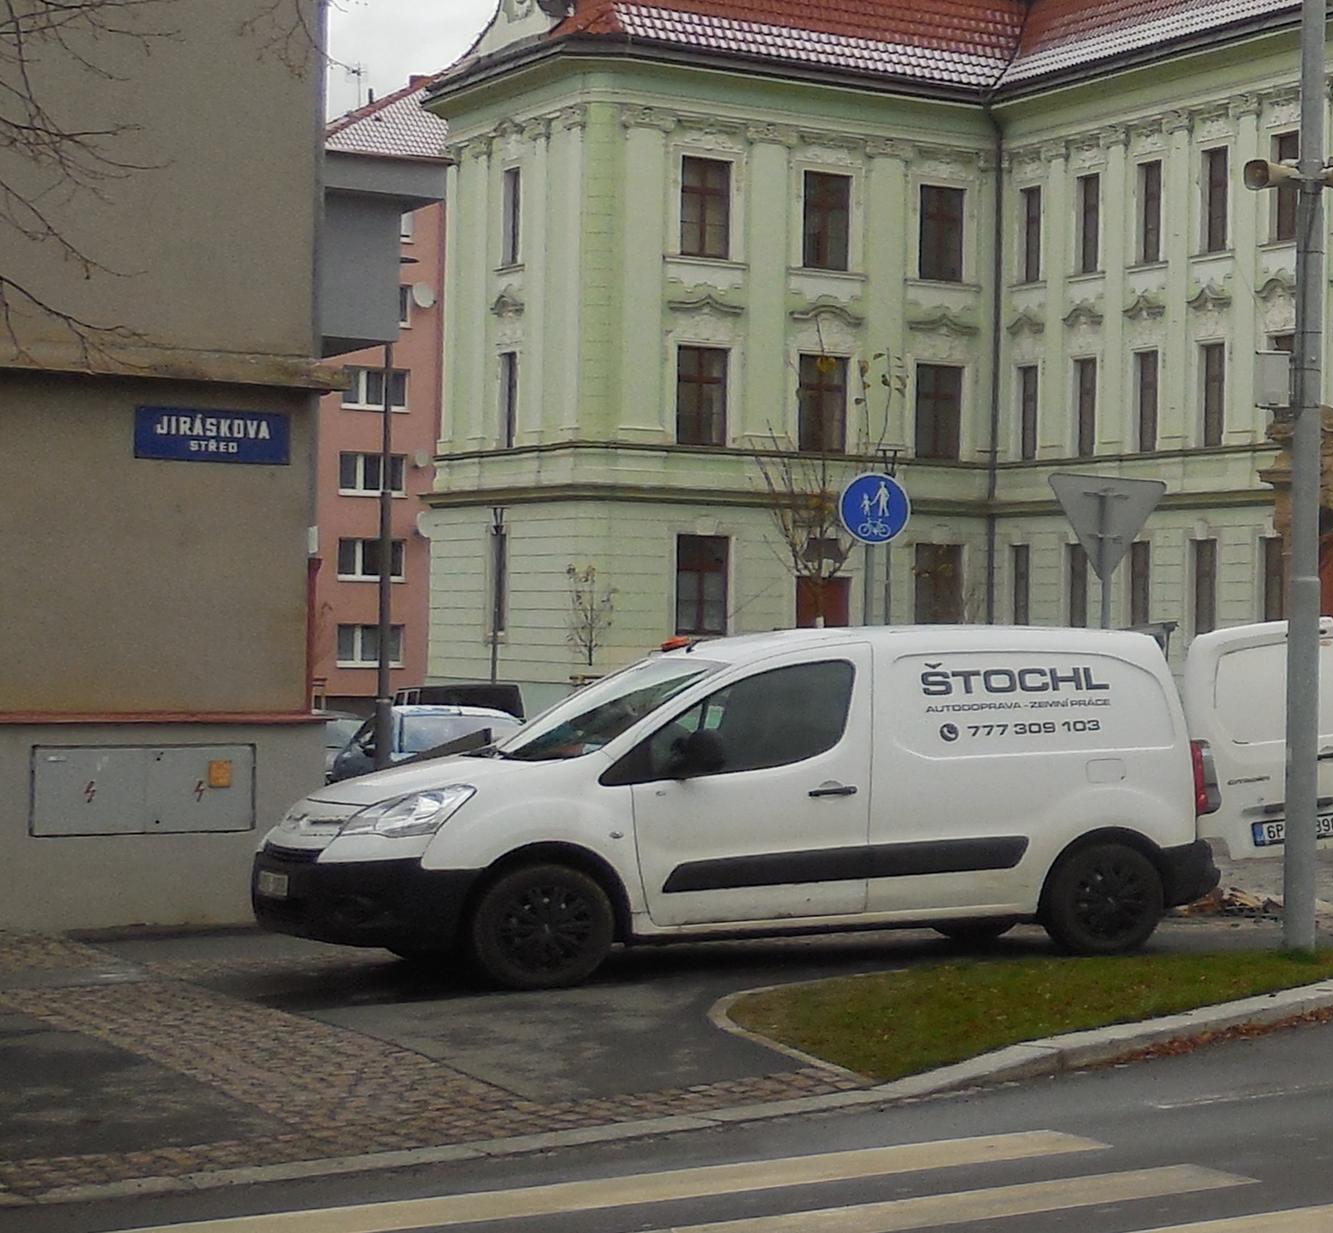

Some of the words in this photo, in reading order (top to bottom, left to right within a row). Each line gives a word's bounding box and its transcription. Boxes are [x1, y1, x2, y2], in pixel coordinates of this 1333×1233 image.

[156, 414, 270, 439] JIRÁSKOVA
[189, 439, 238, 453] STŘED
[921, 662, 1110, 696] ŠTOCHL
[926, 701, 1022, 713] AUTODOPRAVA
[1030, 698, 1069, 709] ZEMNÍ
[1070, 697, 1111, 707] PRÁCE
[967, 724, 1009, 737] 777
[1014, 722, 1056, 735] 309
[1061, 719, 1100, 732] 103
